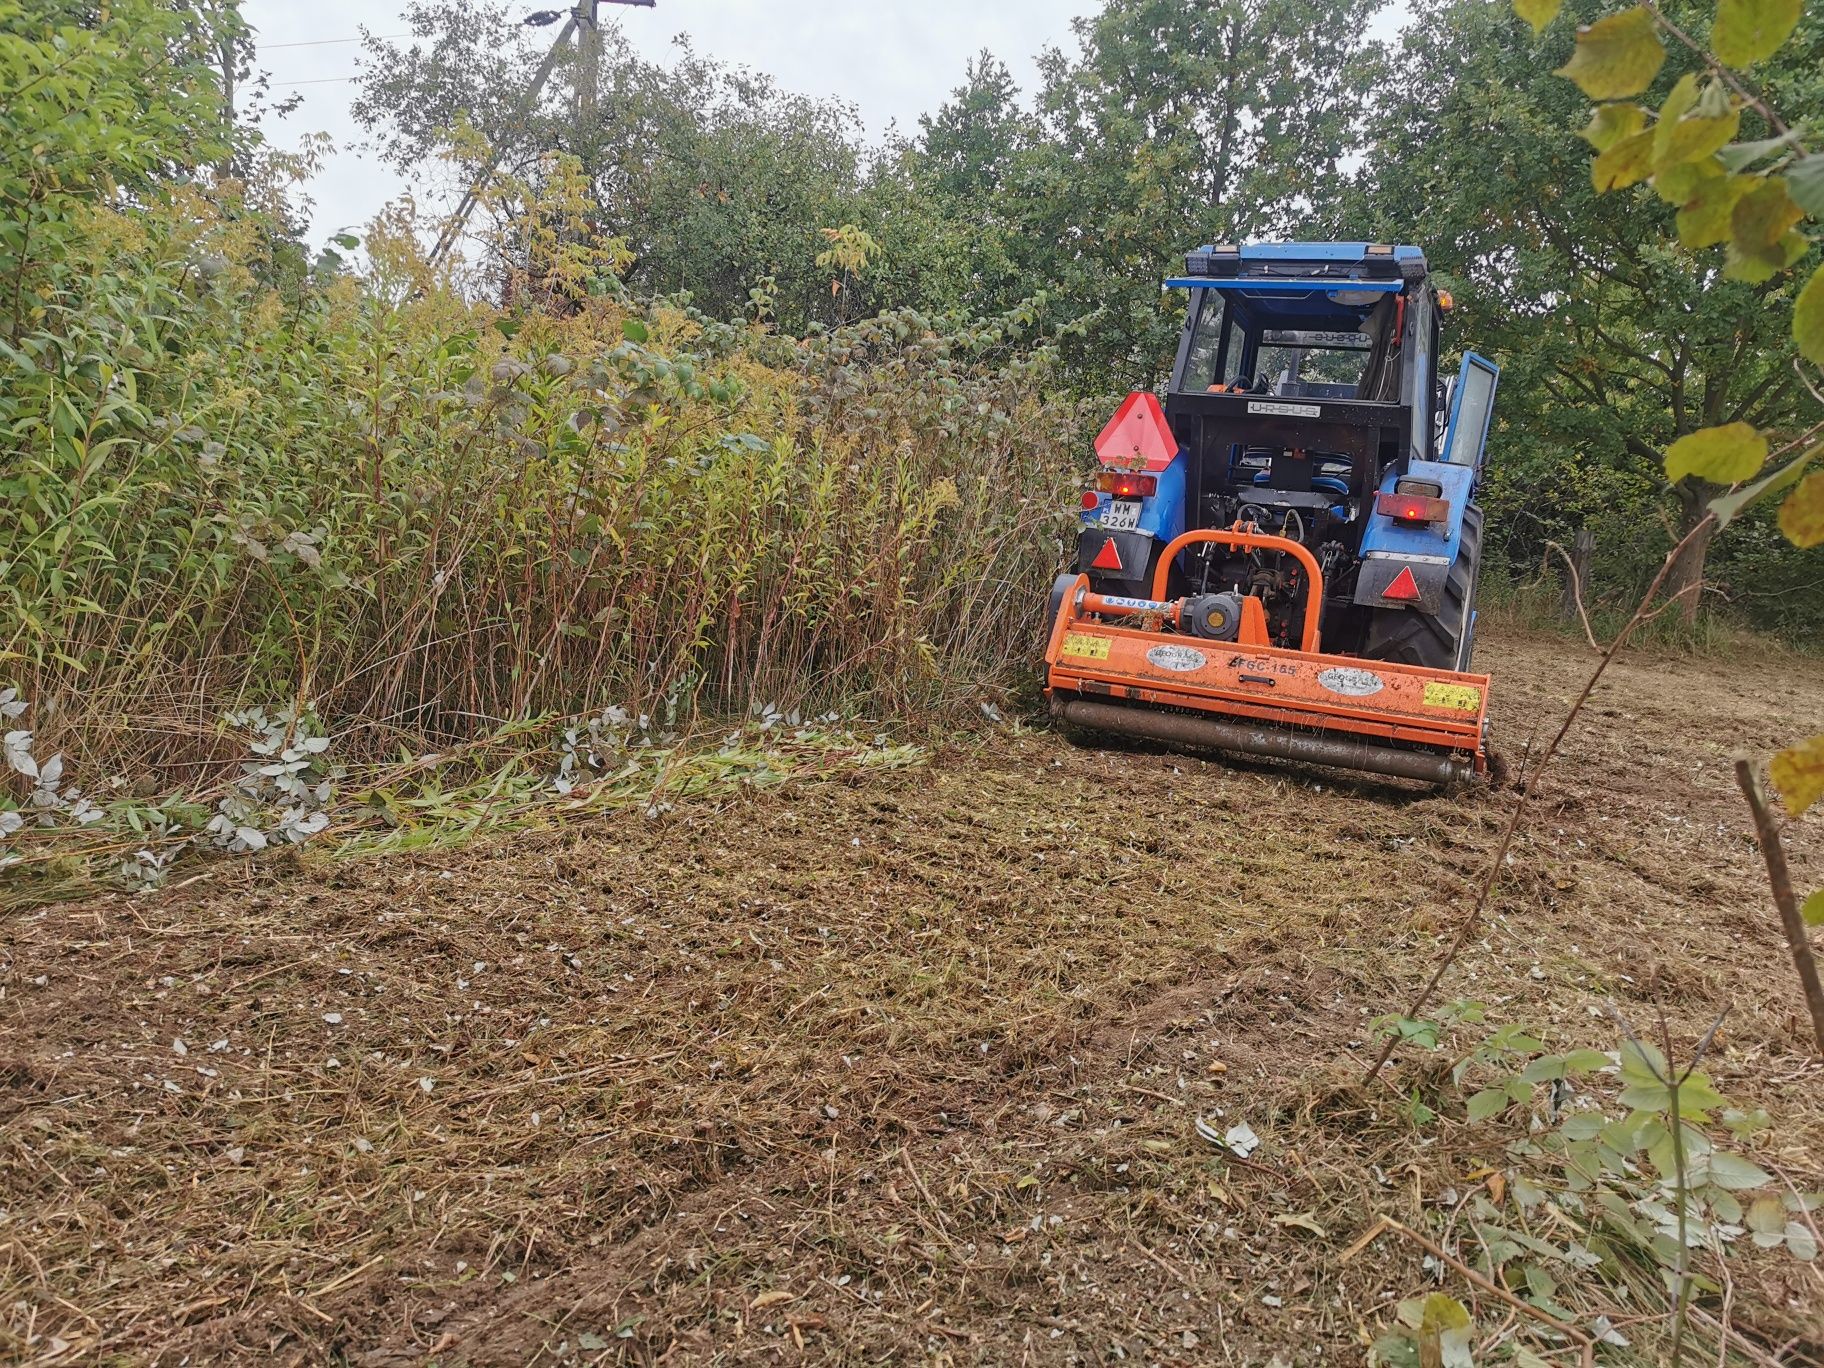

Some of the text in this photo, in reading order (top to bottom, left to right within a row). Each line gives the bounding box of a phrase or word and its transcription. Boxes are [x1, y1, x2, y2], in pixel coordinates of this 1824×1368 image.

[1251, 403, 1318, 416] URSUS
[1114, 503, 1131, 515] WM
[1102, 515, 1136, 528] 326W
